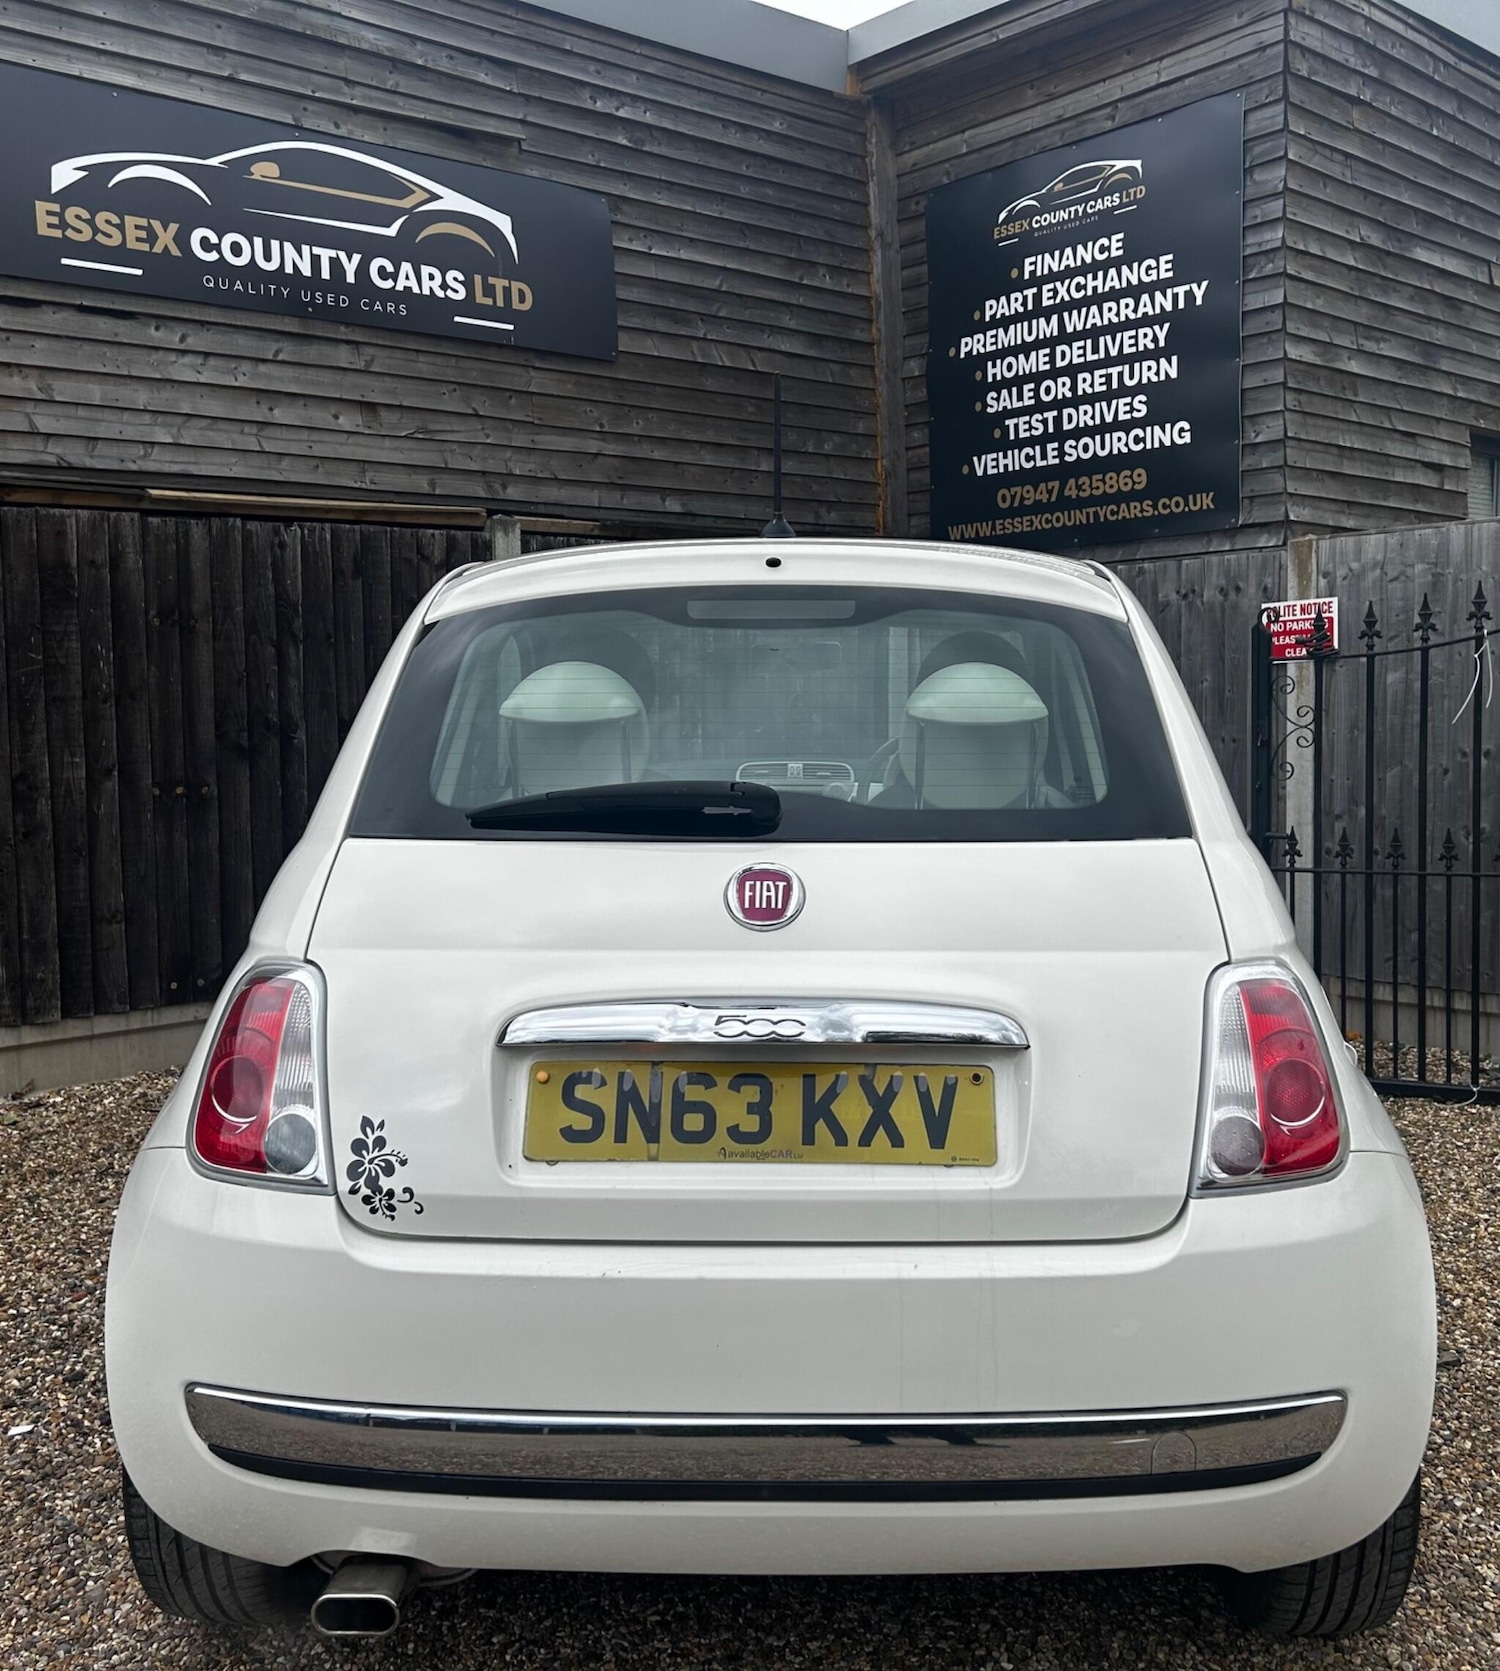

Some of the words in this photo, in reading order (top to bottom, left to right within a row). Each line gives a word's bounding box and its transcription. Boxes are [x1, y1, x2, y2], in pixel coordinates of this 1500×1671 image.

[993, 218, 1031, 240] ESSEX
[1032, 203, 1086, 229] COUNTY
[1086, 193, 1120, 214] CARS
[1122, 185, 1146, 203] LTD
[1034, 226, 1061, 237] QUALITY
[1063, 220, 1080, 230] USED
[1082, 215, 1099, 225] CARS
[35, 200, 182, 257] ESSEX
[190, 227, 362, 284] COUNTY
[368, 256, 467, 301] CARS
[473, 273, 534, 311] LTD
[1023, 232, 1125, 280] FINANCE
[203, 275, 291, 299] QUALITY
[301, 290, 349, 307] USED
[360, 298, 407, 316] CARS
[984, 287, 1038, 322] PART
[1042, 253, 1174, 308] EXCHANGE
[959, 313, 1059, 359] PREMIUM
[1063, 280, 1210, 334] WARRANTY
[987, 347, 1050, 383] HOME
[1055, 322, 1171, 368] DELIVERY
[985, 382, 1035, 414] SALE
[1039, 376, 1072, 402] OR
[1077, 355, 1179, 396] RETURN
[1005, 410, 1058, 440] TEST
[1062, 394, 1148, 431] DRIVES
[972, 442, 1060, 477] VEHICLE
[1063, 420, 1192, 463] SOURCING
[996, 480, 1060, 509] 07947
[1064, 467, 1148, 499] 435869
[948, 491, 1215, 541] WWW.ESSEXCOUNTYCARS.CO.UK
[1270, 622, 1284, 632] NO
[1286, 619, 1329, 632] PARK
[1272, 635, 1299, 645] LEAS
[1285, 647, 1312, 657] CLEA
[744, 880, 788, 909] FIAT
[713, 1014, 806, 1038] 500
[559, 1070, 774, 1145] SN63
[801, 1072, 959, 1150] KXV
